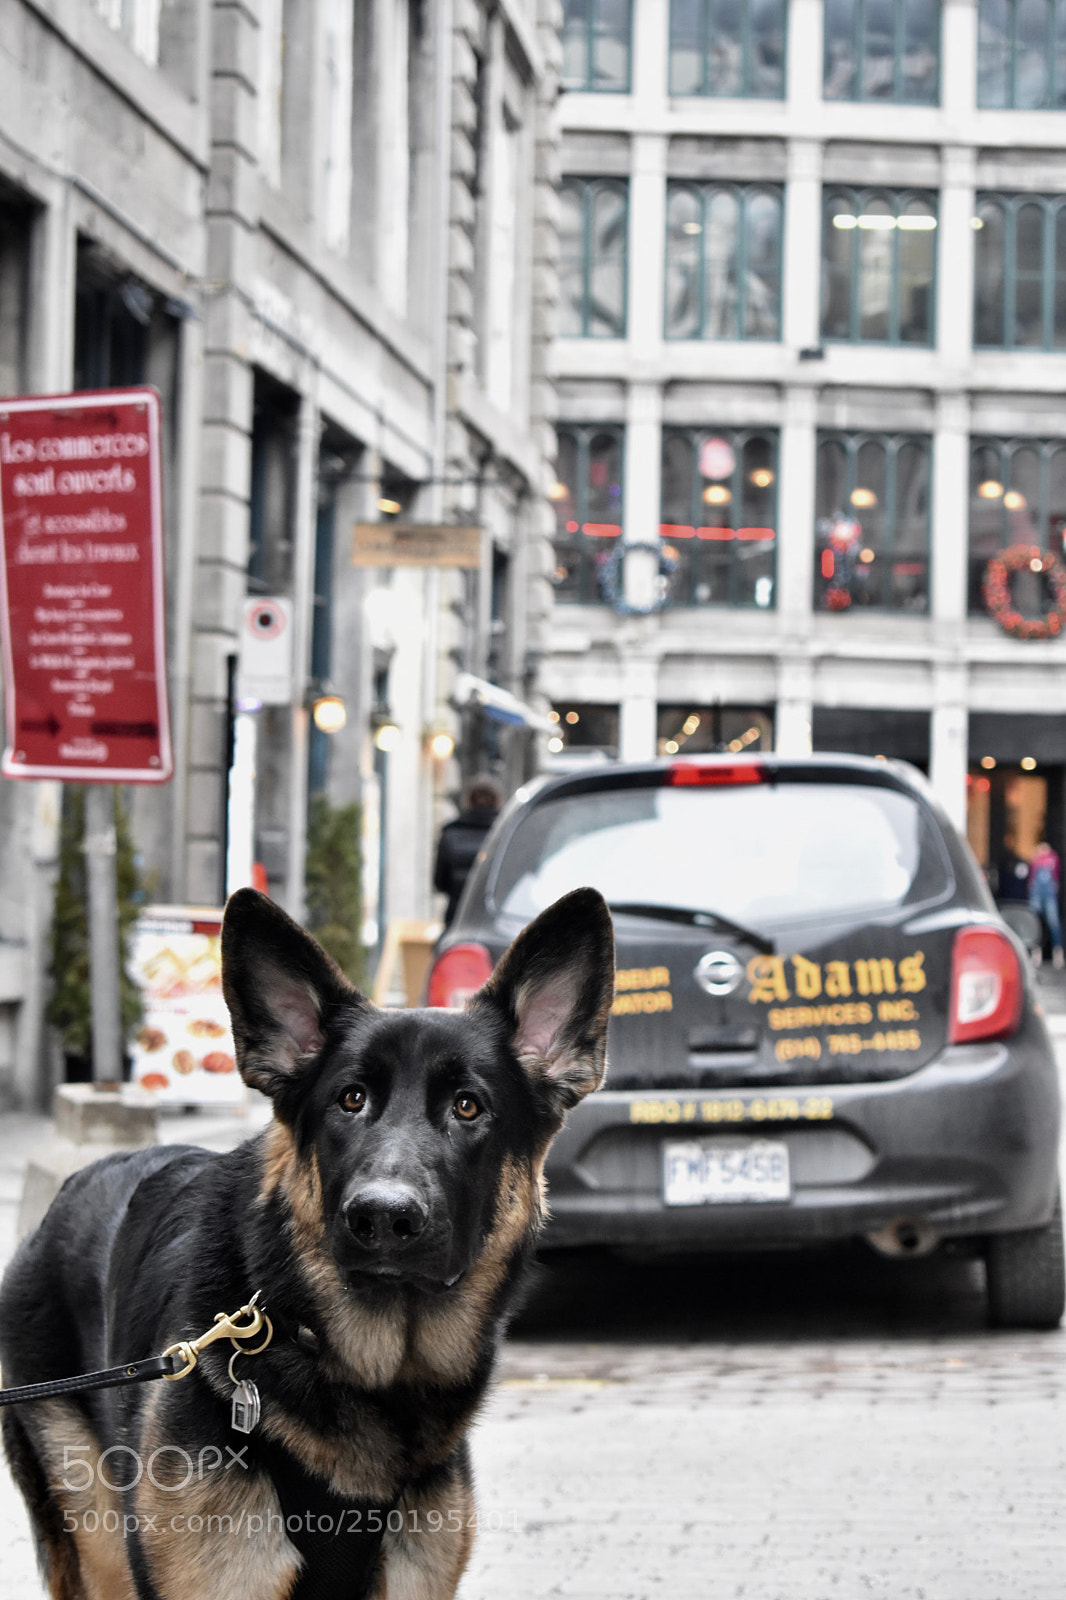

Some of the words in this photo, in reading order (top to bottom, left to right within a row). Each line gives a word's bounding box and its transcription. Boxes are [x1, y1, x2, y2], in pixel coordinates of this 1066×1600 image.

[36, 432, 148, 462] commerces
[57, 463, 136, 494] ouverts
[747, 951, 926, 1003] Adams
[768, 1003, 873, 1030] SERVICES
[877, 1000, 919, 1022] INC.
